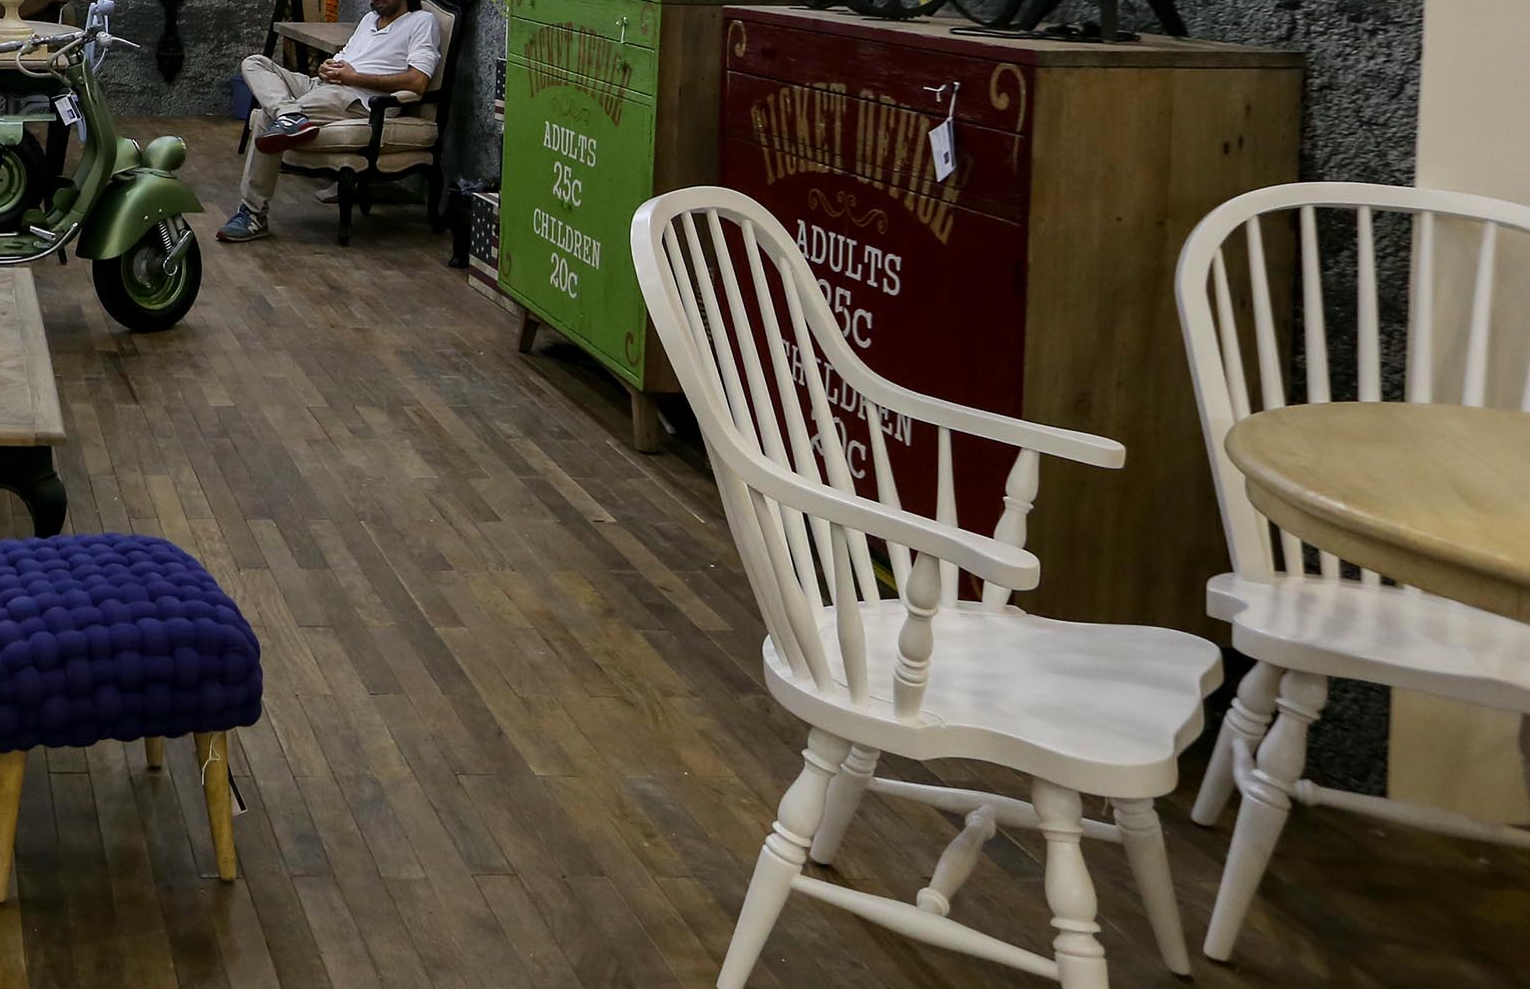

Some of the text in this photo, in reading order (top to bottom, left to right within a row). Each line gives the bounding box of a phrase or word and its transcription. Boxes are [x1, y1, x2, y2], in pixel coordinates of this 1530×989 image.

[542, 120, 597, 168] ADULTS
[751, 82, 847, 186] TICKET
[533, 207, 602, 271] CHILDREN
[796, 218, 903, 297] ADULTS
